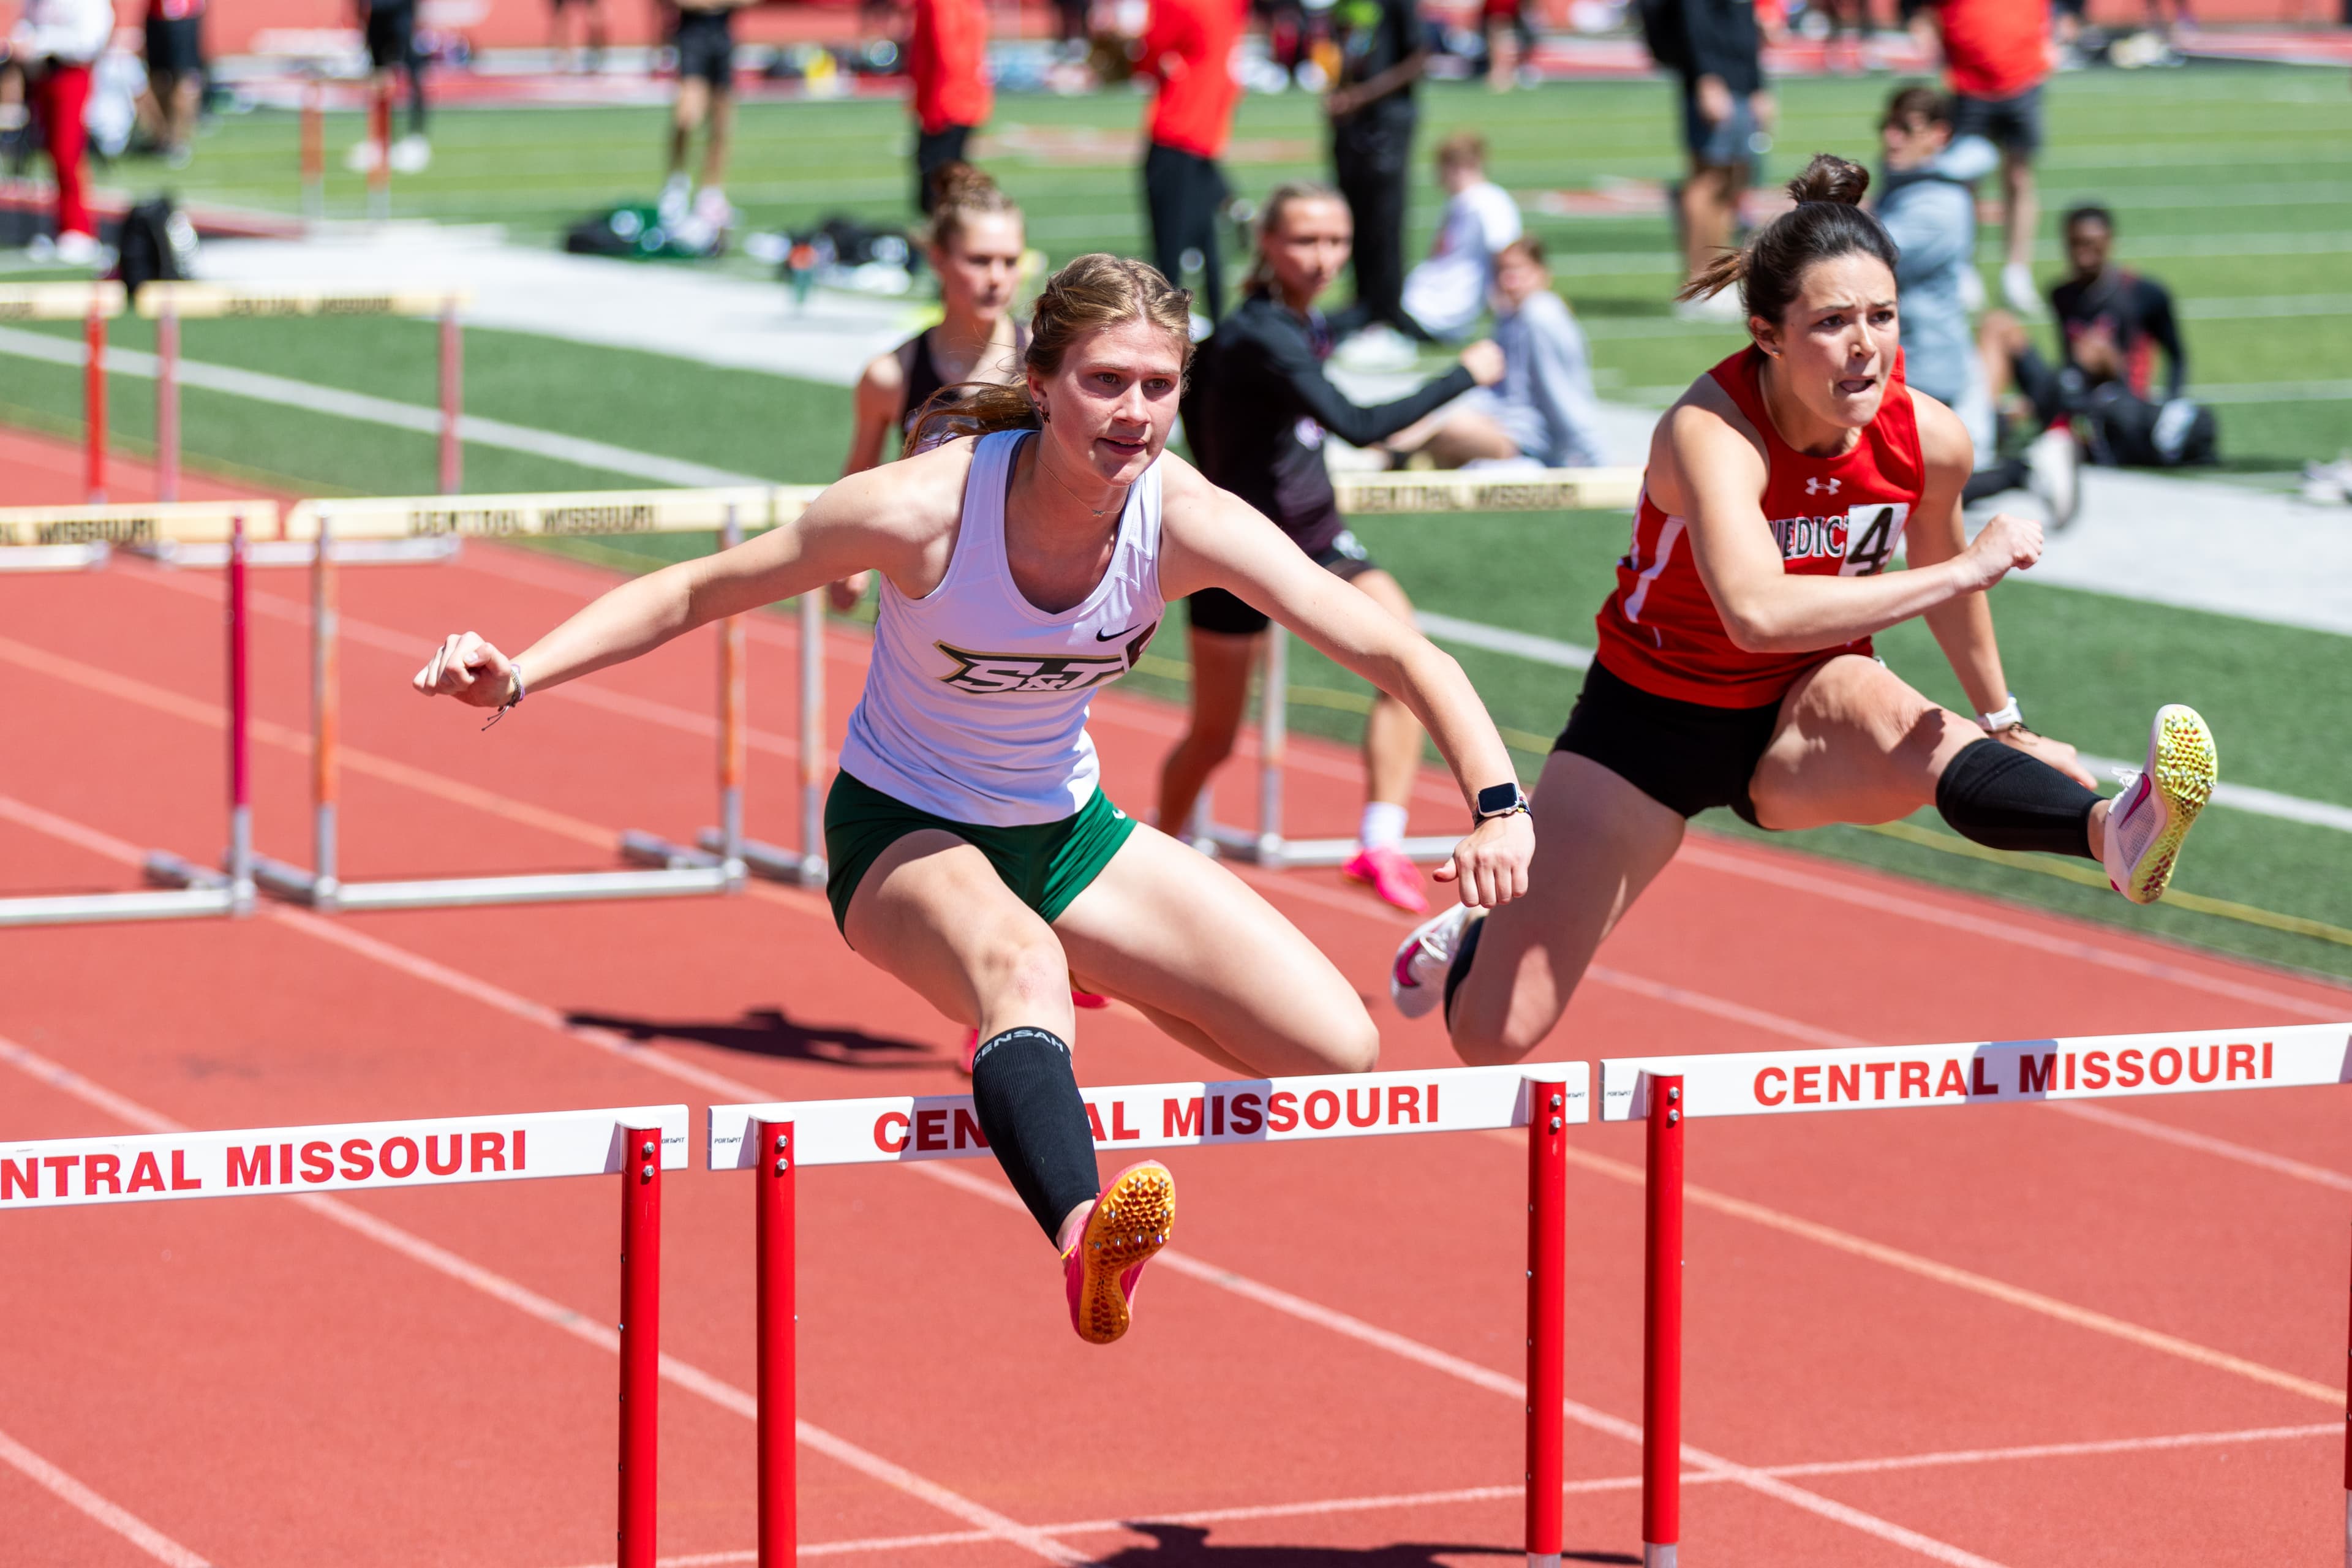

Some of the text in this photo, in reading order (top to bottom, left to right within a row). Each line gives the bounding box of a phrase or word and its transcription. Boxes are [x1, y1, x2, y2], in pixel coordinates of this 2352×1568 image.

[1846, 507, 1894, 576] 4
[1753, 1042, 2274, 1107] CENTRAL MISSOURI
[873, 1084, 1439, 1153] CENAL MISSOURI
[227, 1130, 526, 1188] MISSOURI
